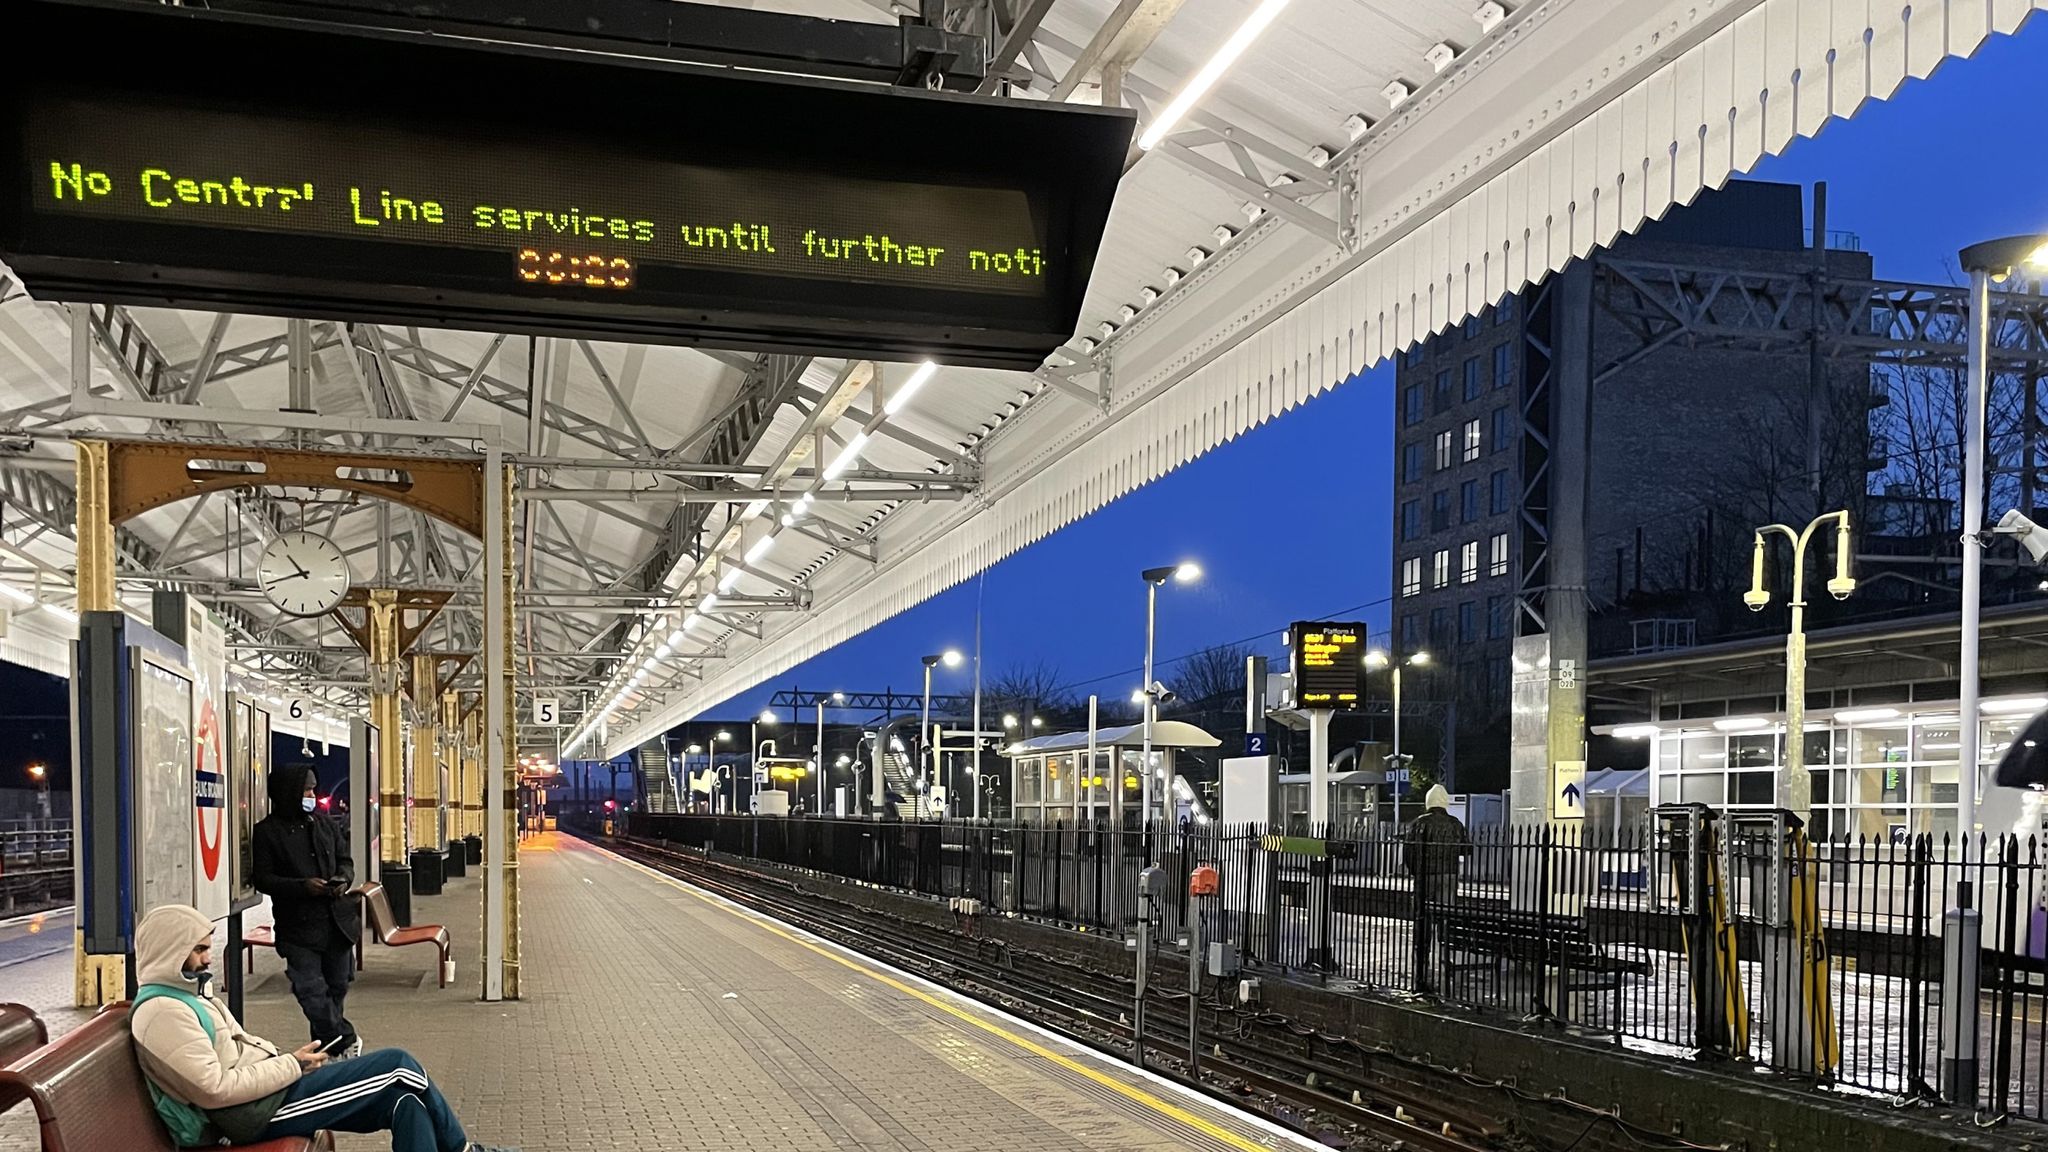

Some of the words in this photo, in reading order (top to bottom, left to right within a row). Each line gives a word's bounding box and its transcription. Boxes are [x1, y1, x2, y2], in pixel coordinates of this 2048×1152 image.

[51, 162, 112, 200] No
[350, 188, 444, 226] Line
[472, 207, 655, 241] services
[681, 223, 776, 252] until
[801, 230, 945, 266] further
[969, 248, 1046, 275] noti
[289, 699, 303, 719] 6
[540, 704, 553, 723] 5
[1250, 737, 1262, 752] 2
